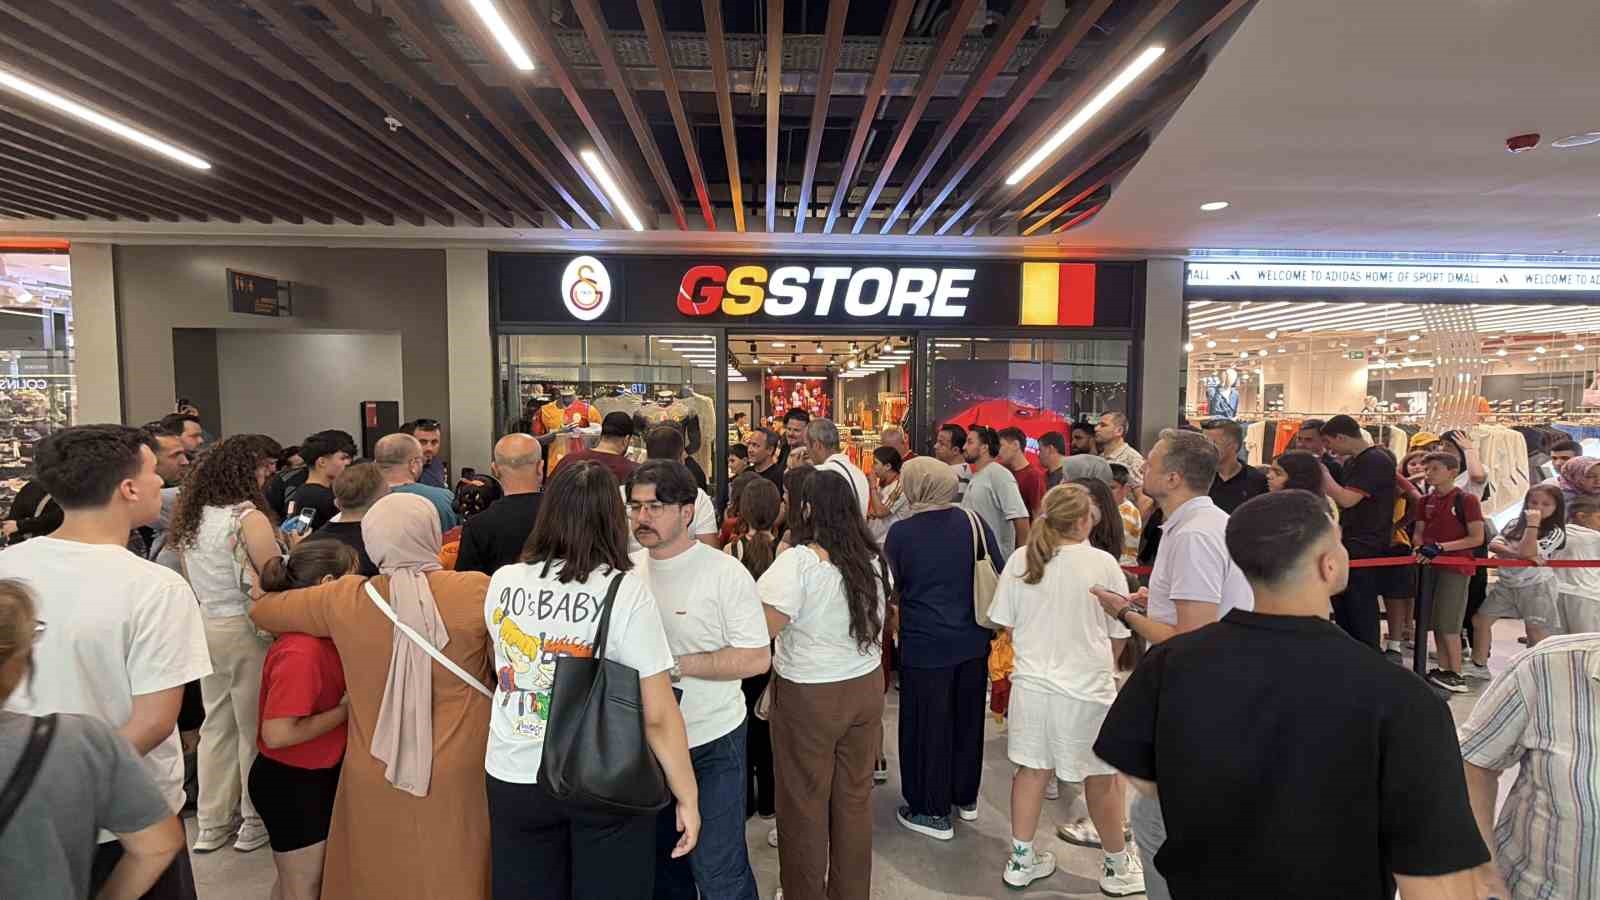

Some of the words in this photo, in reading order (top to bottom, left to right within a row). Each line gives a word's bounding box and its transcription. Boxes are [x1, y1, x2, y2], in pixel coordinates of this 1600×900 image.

[1257, 269, 1307, 281] WELCOME
[1311, 270, 1322, 281] TO
[1325, 270, 1361, 282] ADIDAS
[1365, 271, 1393, 282] HOME
[1397, 271, 1410, 282] OF
[1413, 271, 1444, 283] SPORT
[1525, 273, 1573, 285] WELCOME
[1576, 273, 1588, 285] TO
